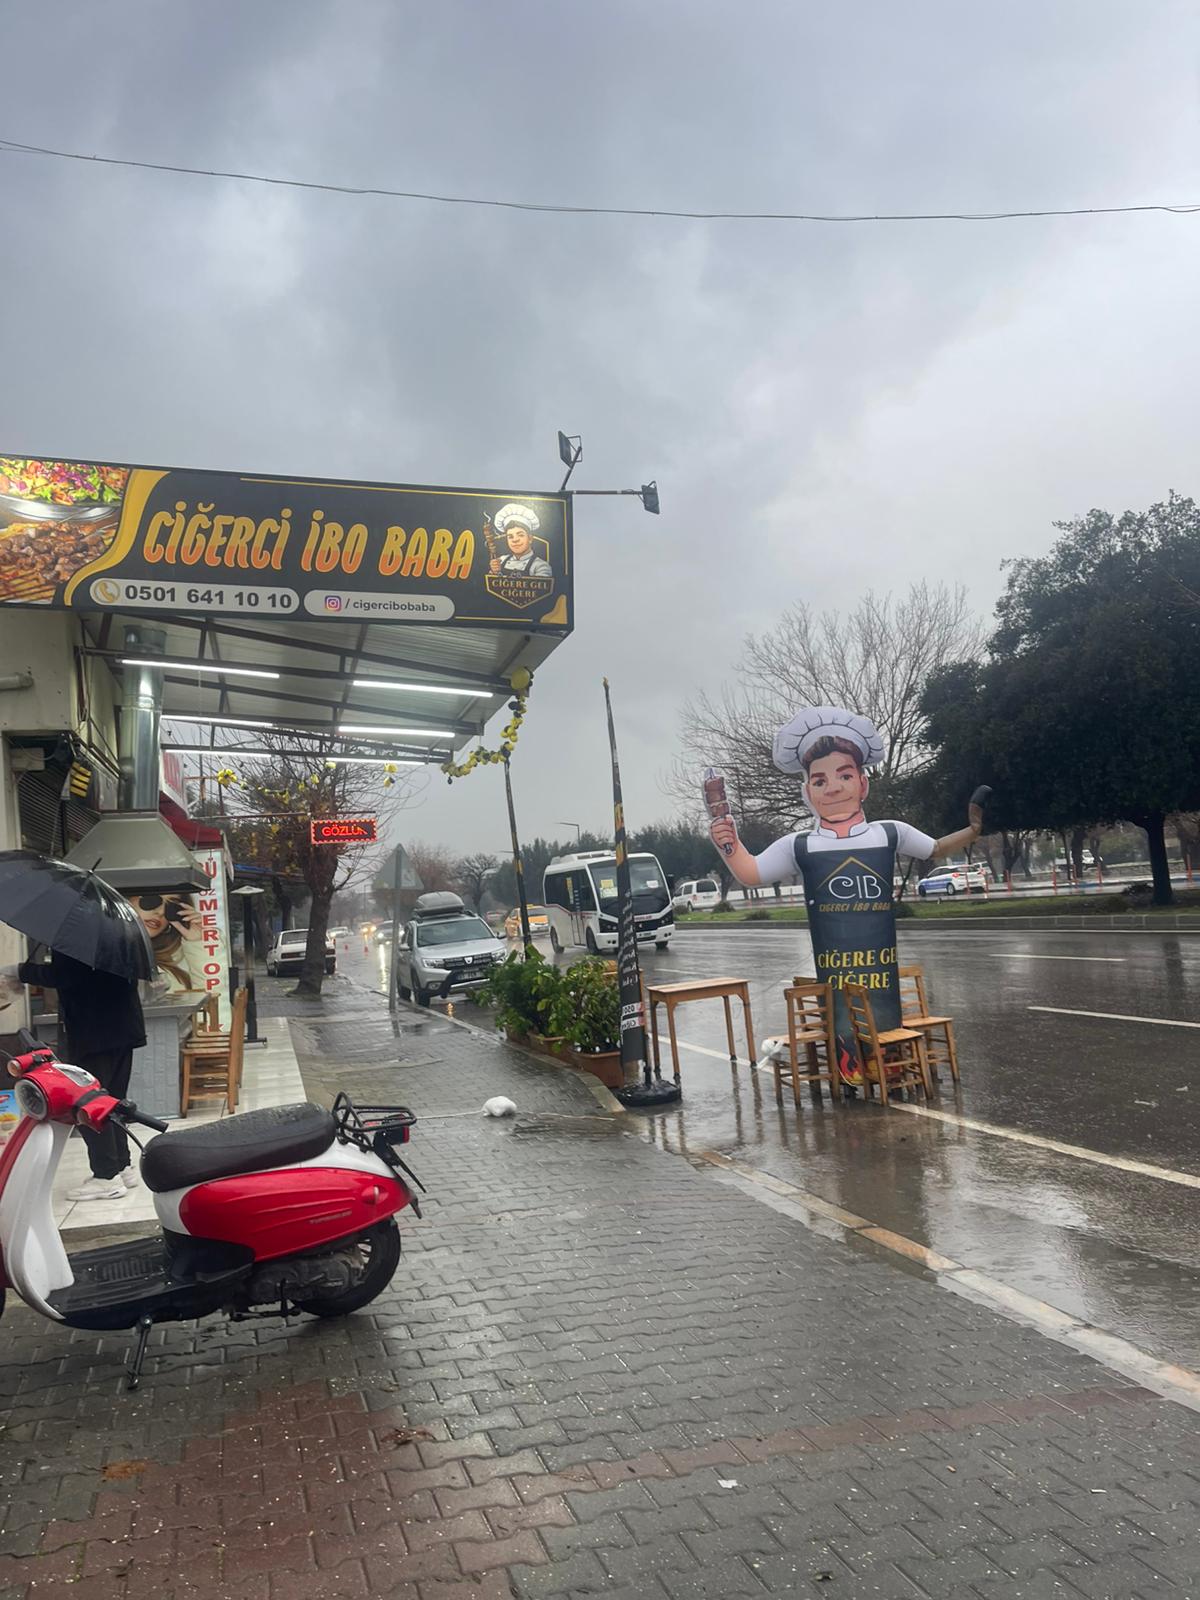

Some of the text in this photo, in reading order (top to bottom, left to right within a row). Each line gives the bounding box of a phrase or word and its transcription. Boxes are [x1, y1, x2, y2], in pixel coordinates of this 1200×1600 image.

[143, 500, 475, 579] CİĞERCİ İBO BABA
[125, 584, 292, 609] 0501 641 10 10
[353, 600, 436, 612] cigercibobaba
[199, 898, 219, 957] MERT
[817, 949, 876, 969] CİĞERE
